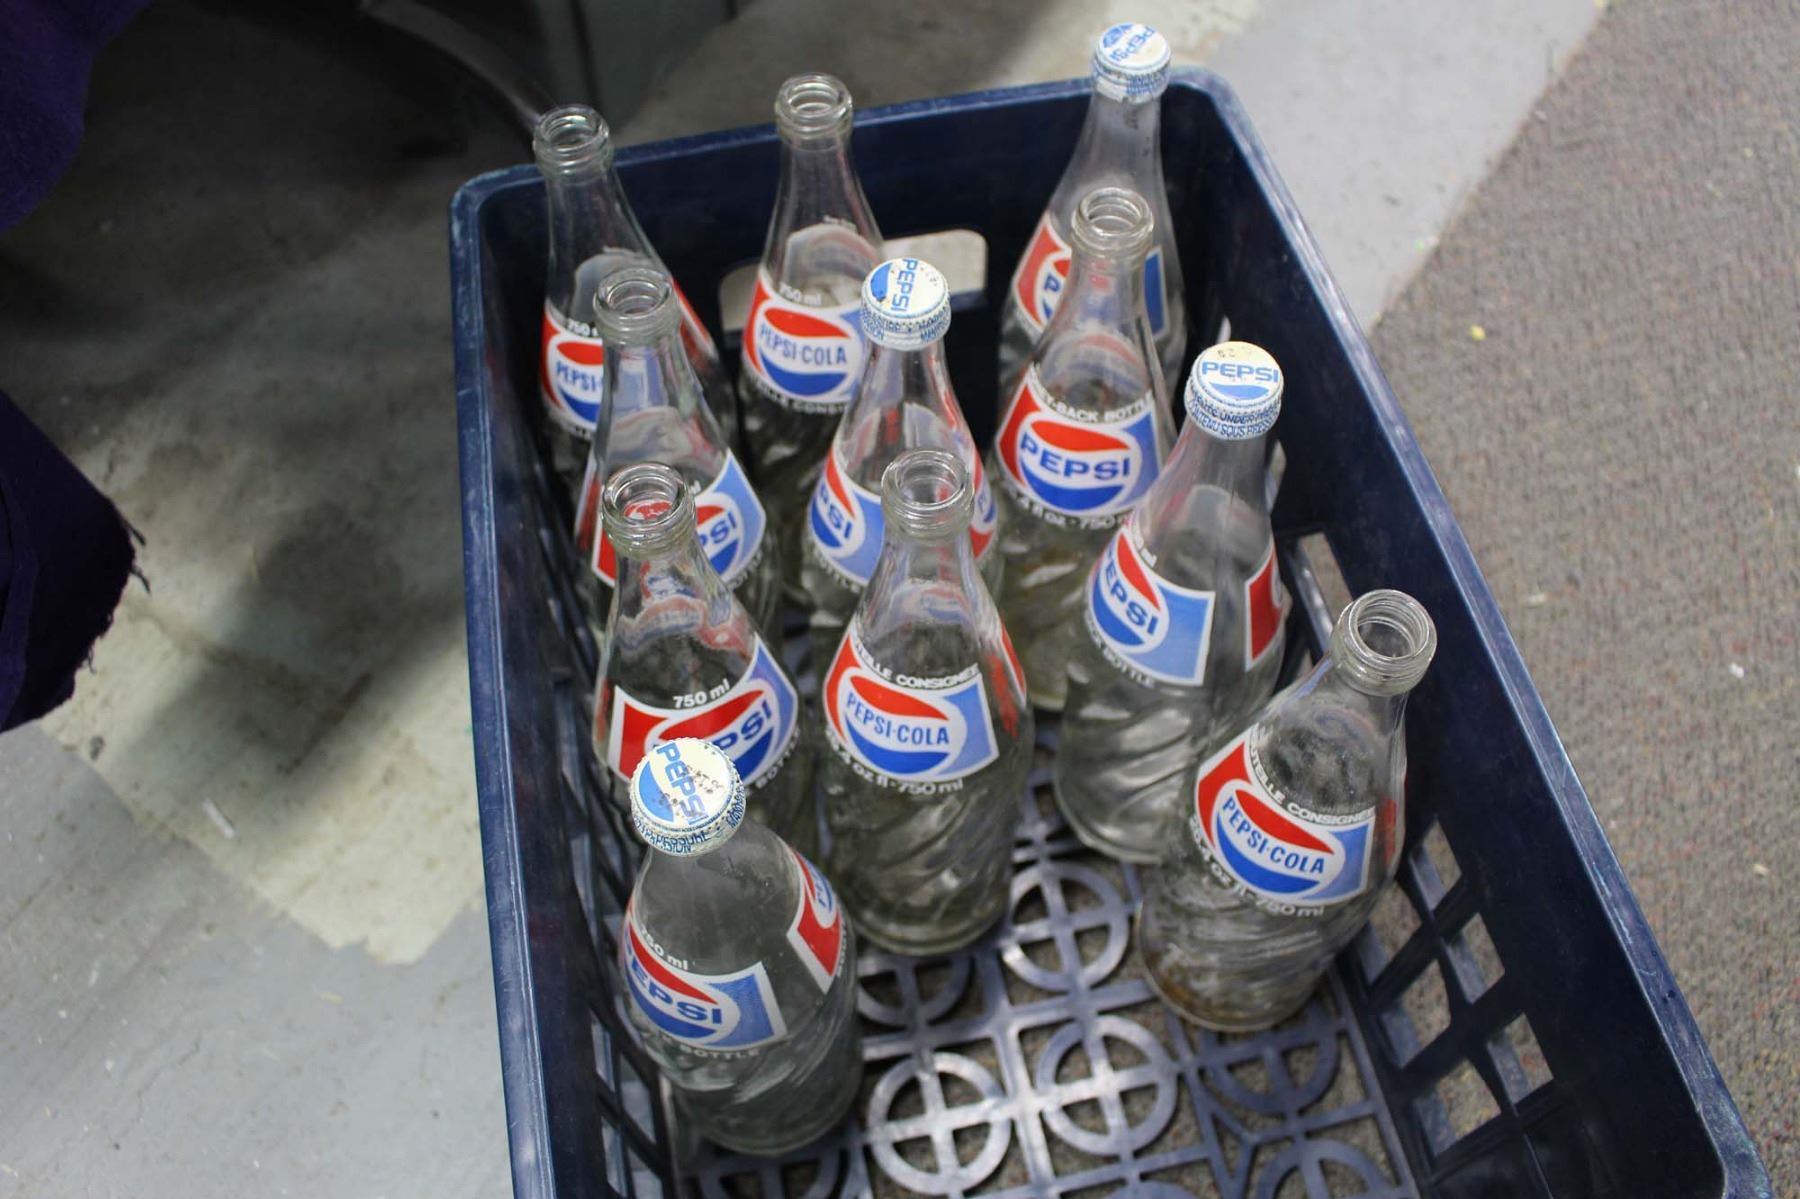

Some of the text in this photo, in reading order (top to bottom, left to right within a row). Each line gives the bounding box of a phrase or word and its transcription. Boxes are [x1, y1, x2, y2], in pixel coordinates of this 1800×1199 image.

[1109, 25, 1155, 61] PEPSI
[891, 258, 919, 311] PEPSI
[1201, 361, 1279, 383] PEPSI
[1020, 433, 1130, 481] PEPSI
[673, 678, 731, 709] 750 ml
[656, 741, 710, 827] PEPSI
[667, 954, 689, 971] ml
